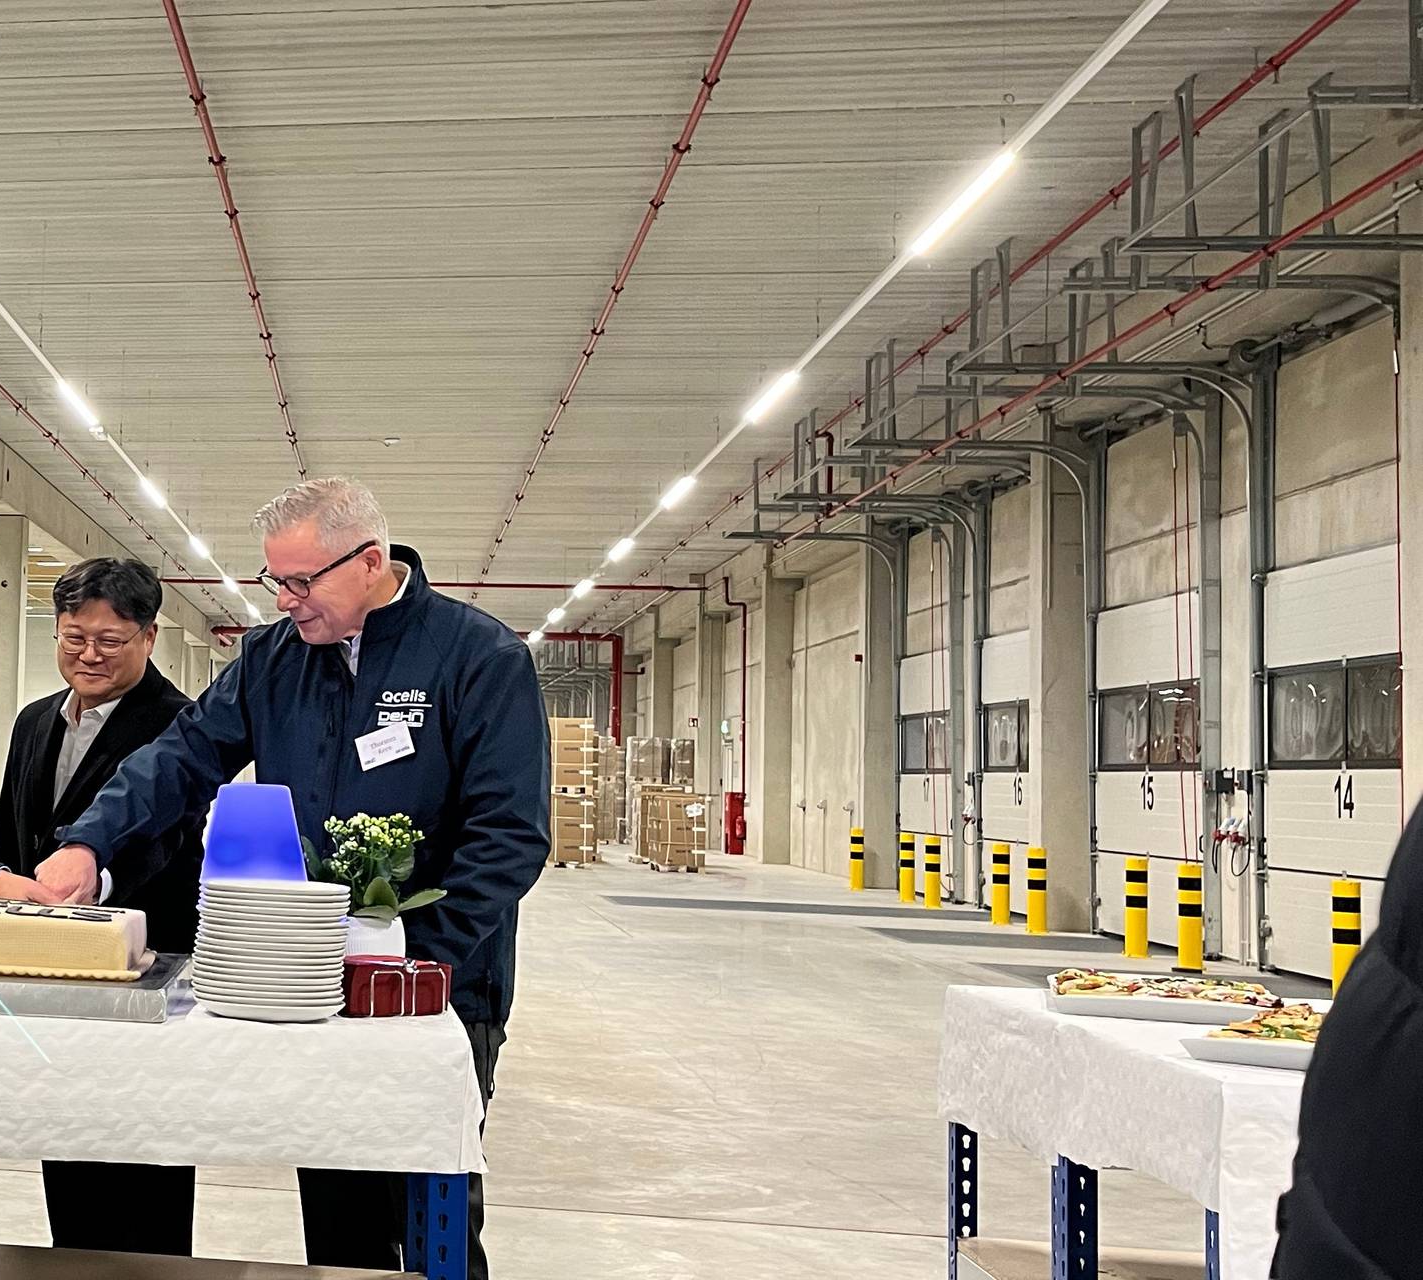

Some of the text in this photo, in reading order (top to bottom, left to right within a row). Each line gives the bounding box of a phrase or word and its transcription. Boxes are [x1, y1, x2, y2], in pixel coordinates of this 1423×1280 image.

[381, 689, 427, 703] Qcells
[1013, 776, 1023, 806] 16
[1140, 775, 1154, 811] 15
[1334, 774, 1355, 819] 14
